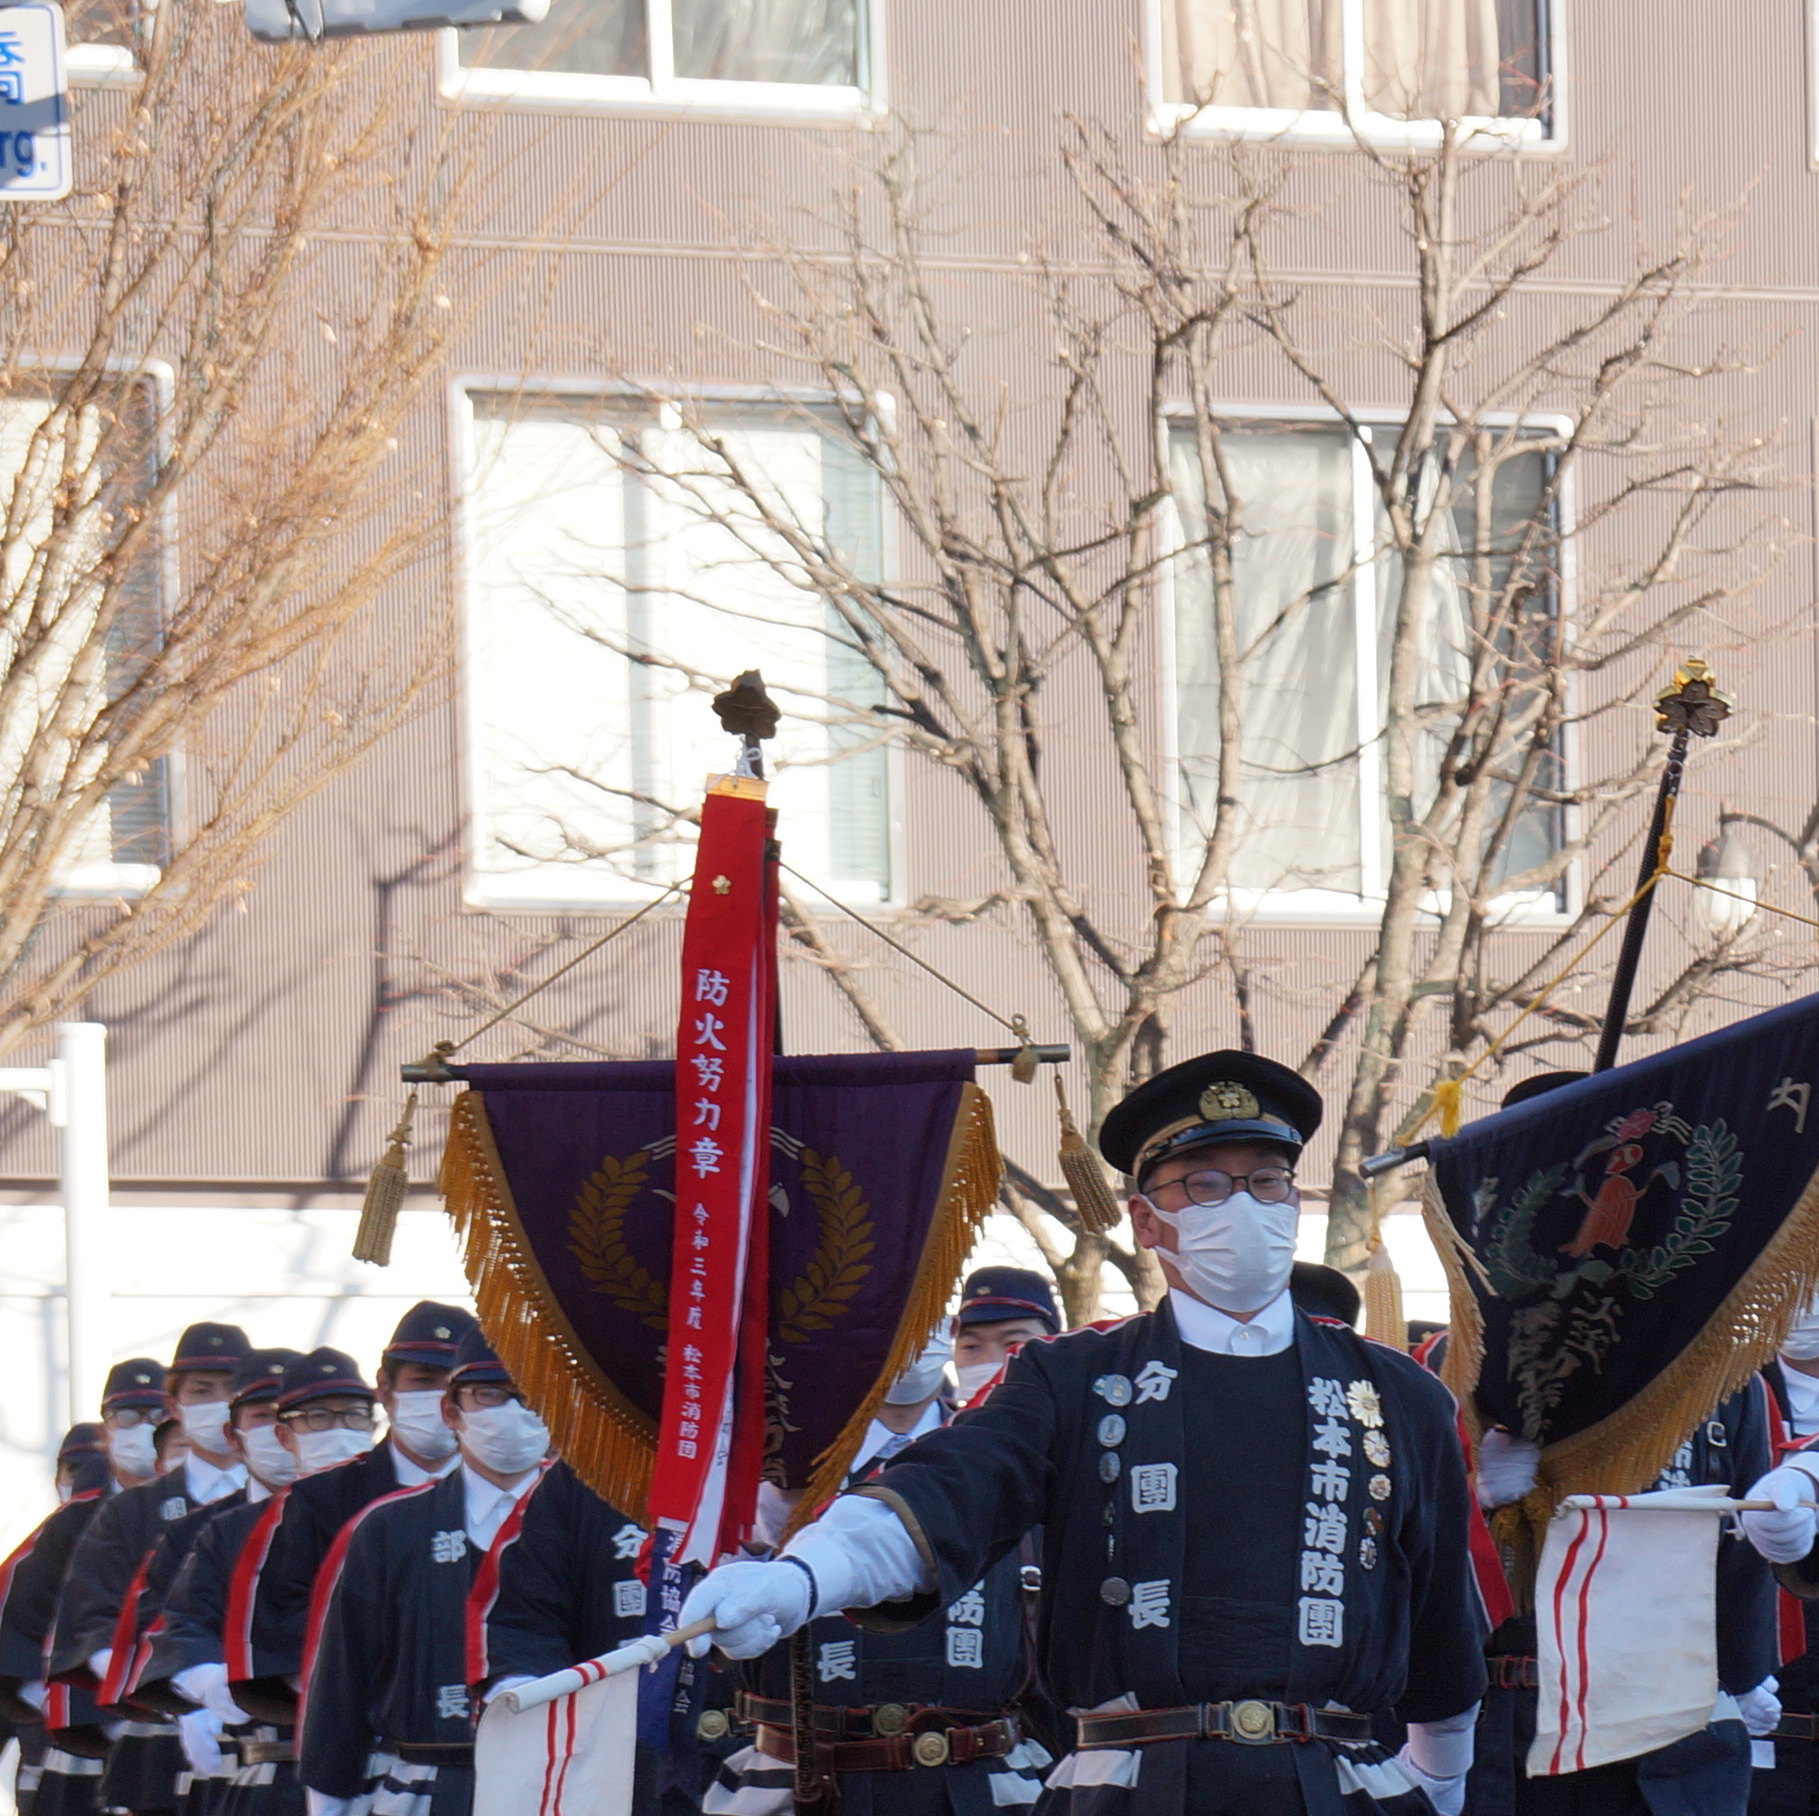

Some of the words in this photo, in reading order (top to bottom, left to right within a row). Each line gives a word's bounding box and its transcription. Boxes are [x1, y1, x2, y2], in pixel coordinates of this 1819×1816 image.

[688, 968, 730, 1179] 防火努力章
[687, 1203, 711, 1330] 令和三年度
[611, 1523, 649, 1649] 分團
